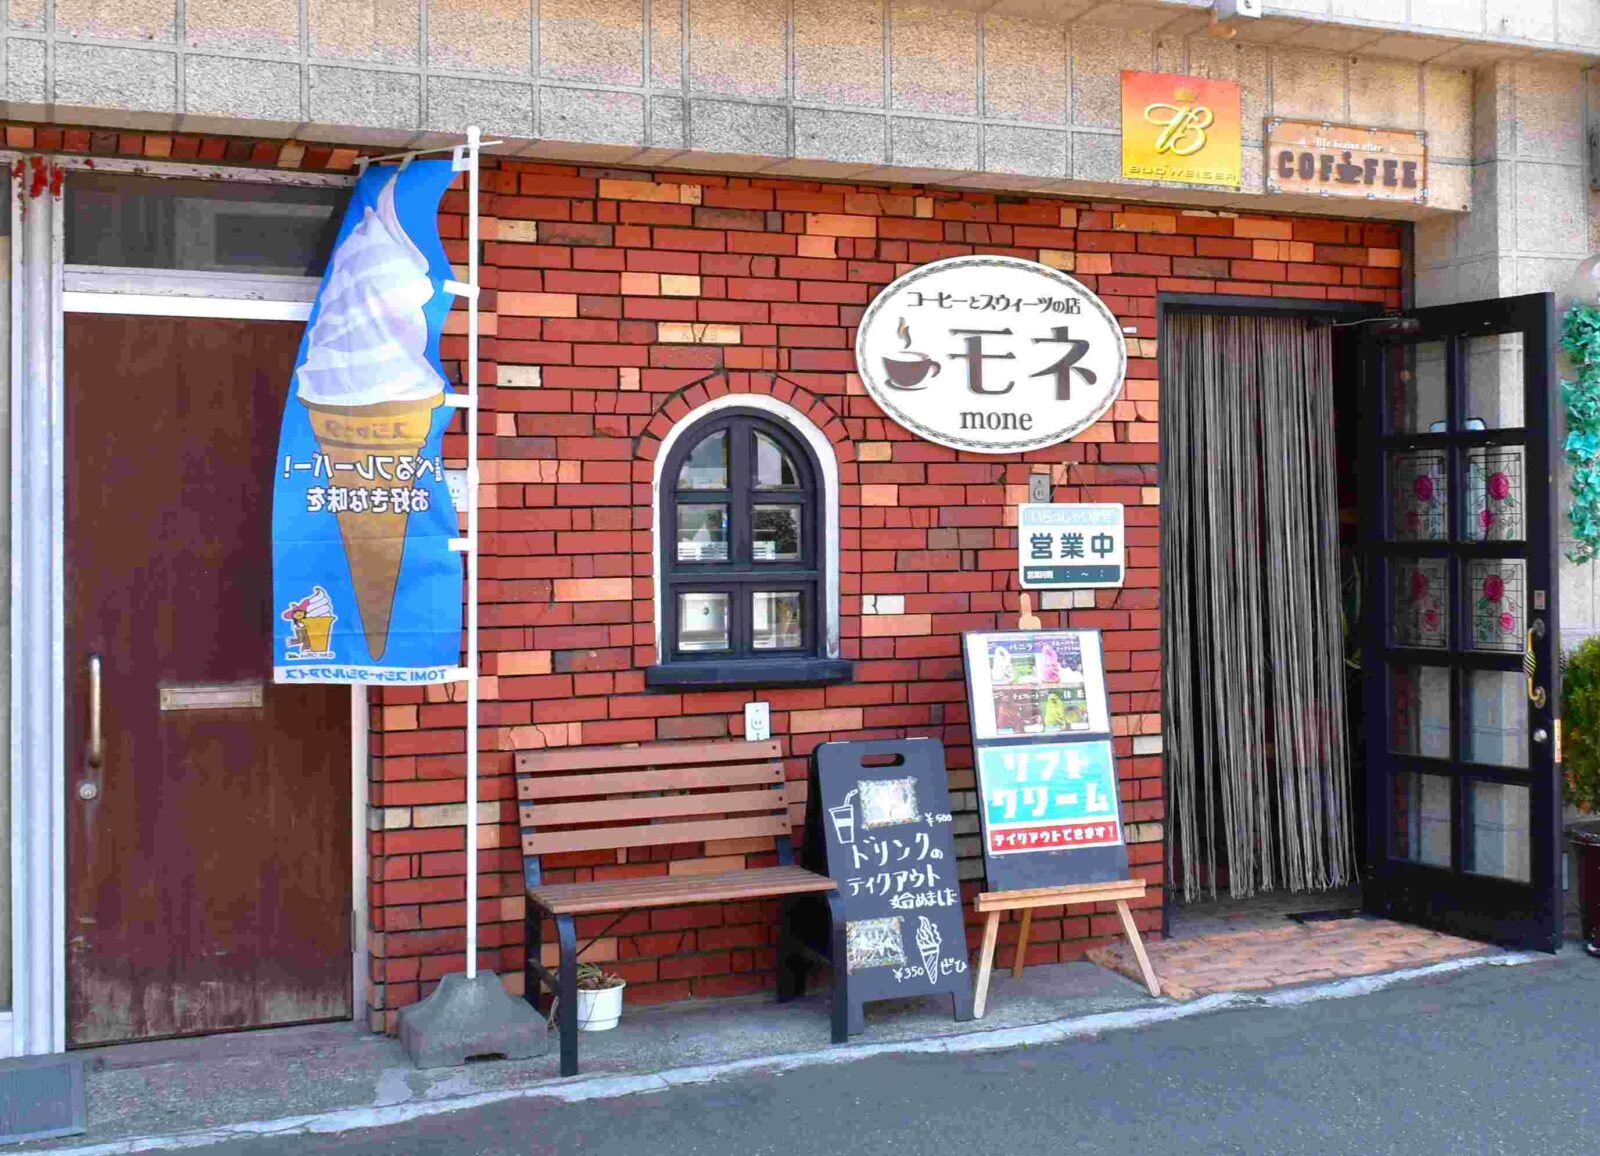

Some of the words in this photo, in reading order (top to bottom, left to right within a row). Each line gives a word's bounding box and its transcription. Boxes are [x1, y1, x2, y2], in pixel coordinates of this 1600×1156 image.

[907, 291, 1081, 315] コーヒーとスウィーツの店
[947, 325, 1097, 401] モネ
[959, 410, 1033, 431] mone
[1030, 532, 1114, 559] 営業中
[991, 782, 1109, 819] クリーム
[852, 832, 944, 869] ドリンクの
[889, 887, 957, 910] 始めました
[892, 966, 924, 983] ¥350
[940, 957, 968, 975] ぜひ
